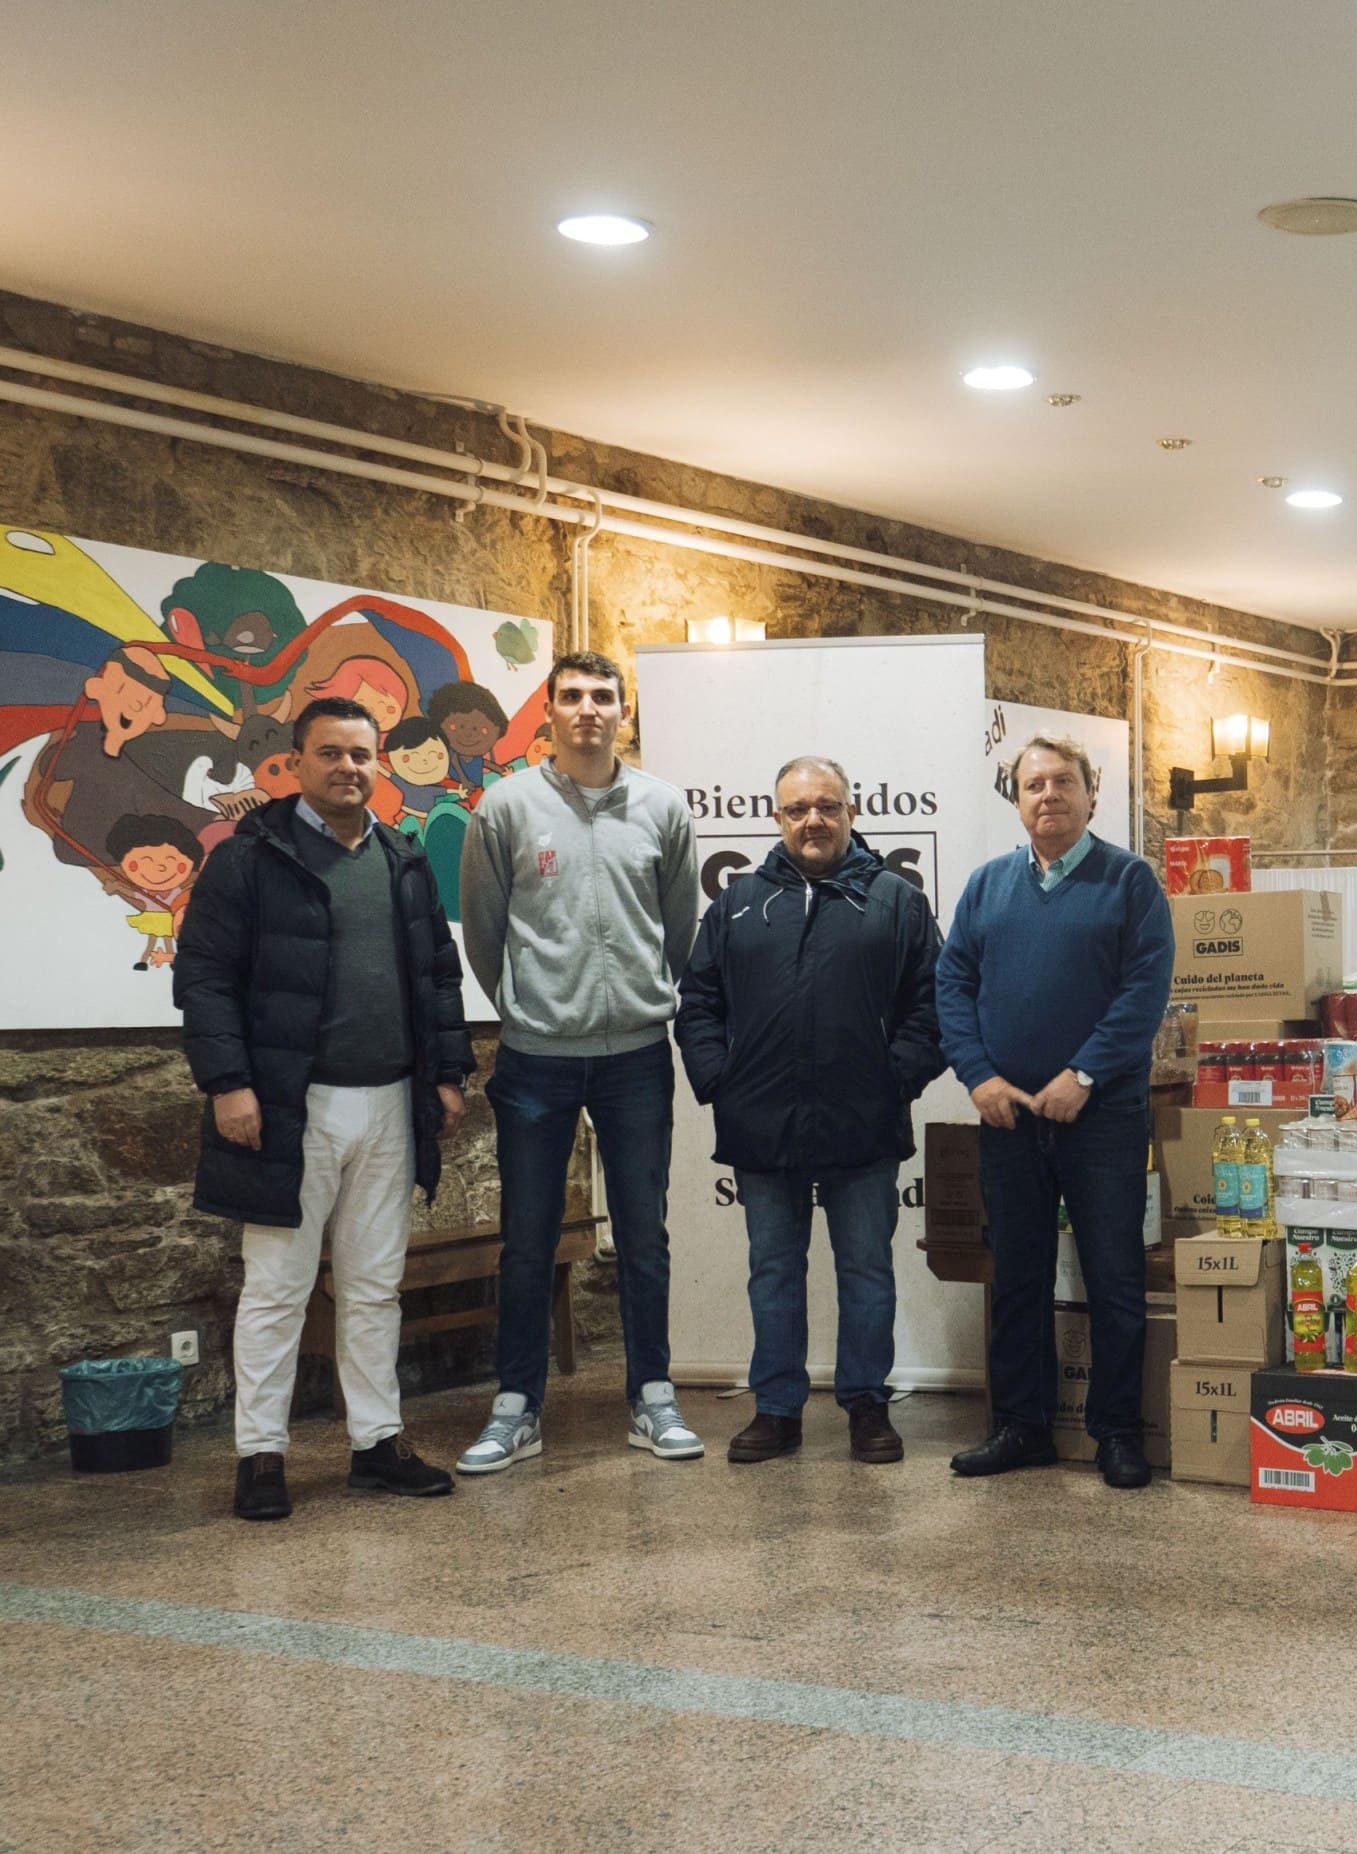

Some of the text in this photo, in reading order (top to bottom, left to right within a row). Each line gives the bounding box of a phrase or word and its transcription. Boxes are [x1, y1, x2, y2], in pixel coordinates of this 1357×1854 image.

[684, 782, 938, 820] Bienidos
[1195, 940, 1241, 955] GADIS
[1173, 972, 1265, 985] Cuido del planeta
[1291, 1234, 1320, 1242] Nuestro
[1198, 1256, 1239, 1271] 15x1L
[1195, 1381, 1237, 1397] 15x1L
[1272, 1408, 1320, 1429] ABRIL
[1332, 1413, 1353, 1423] Aceite
